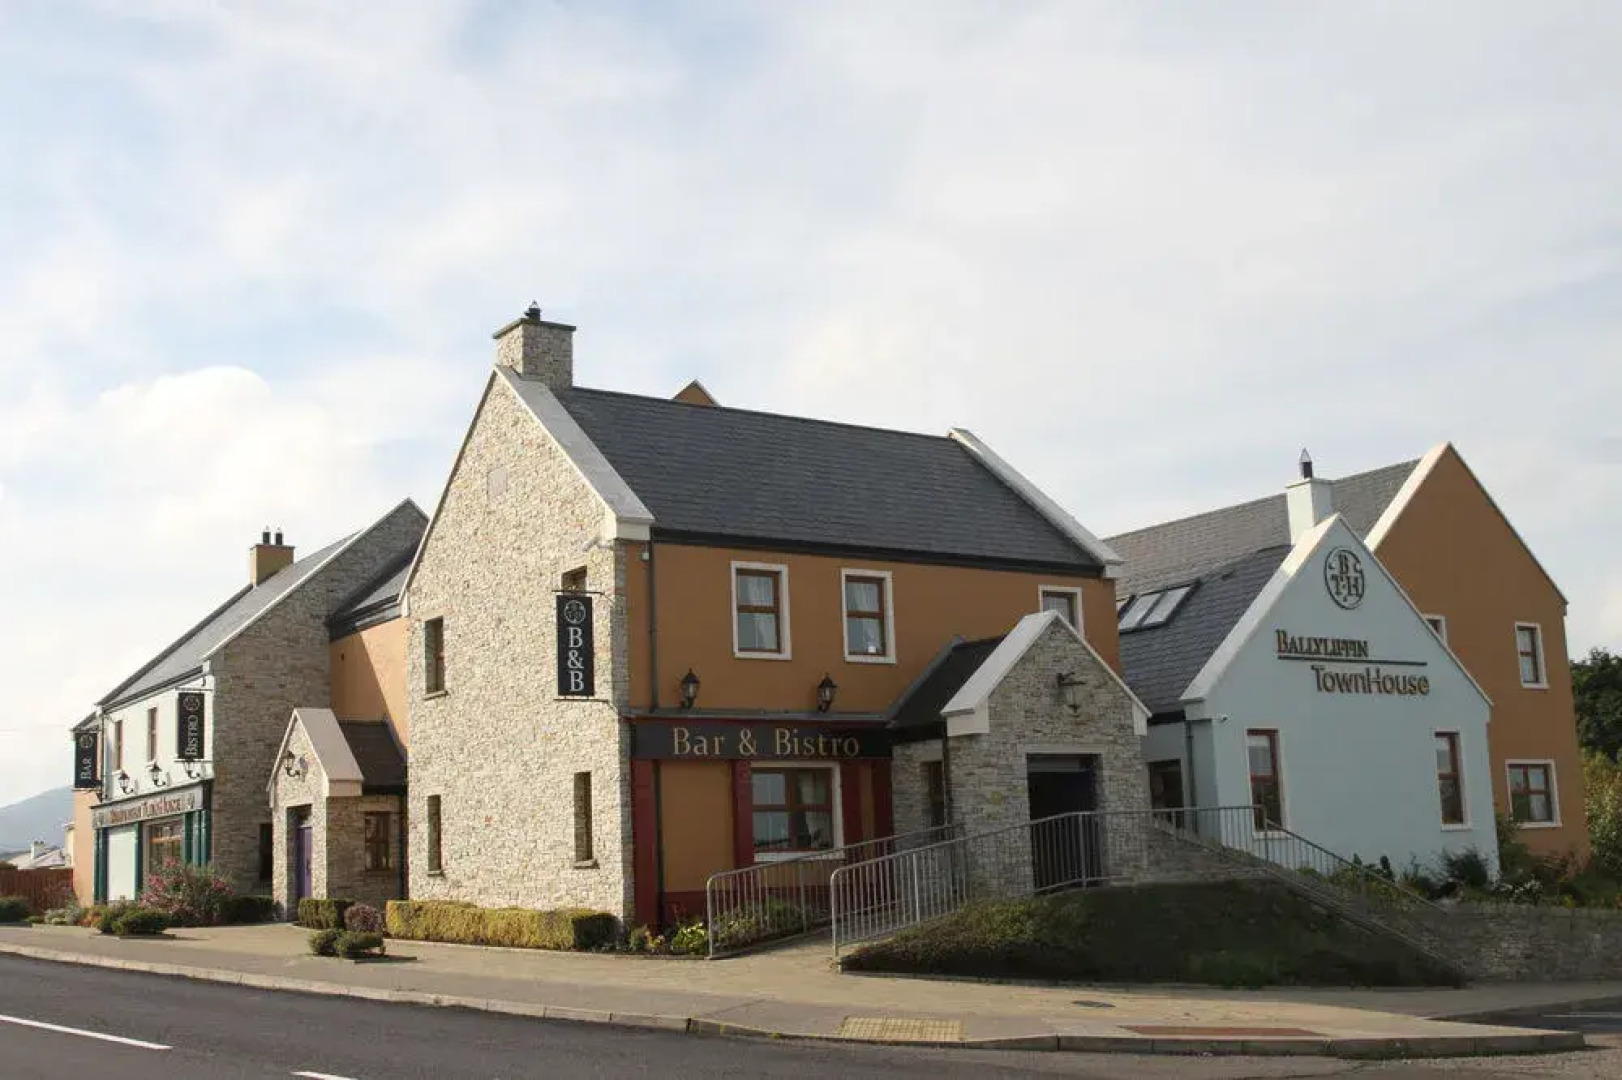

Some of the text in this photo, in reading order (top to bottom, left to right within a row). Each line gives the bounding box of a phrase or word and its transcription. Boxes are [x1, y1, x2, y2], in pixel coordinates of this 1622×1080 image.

[566, 627, 585, 692] B&B
[185, 714, 198, 756] BISTRO
[673, 728, 860, 757] Bar & Bistro
[80, 757, 92, 779] BAR
